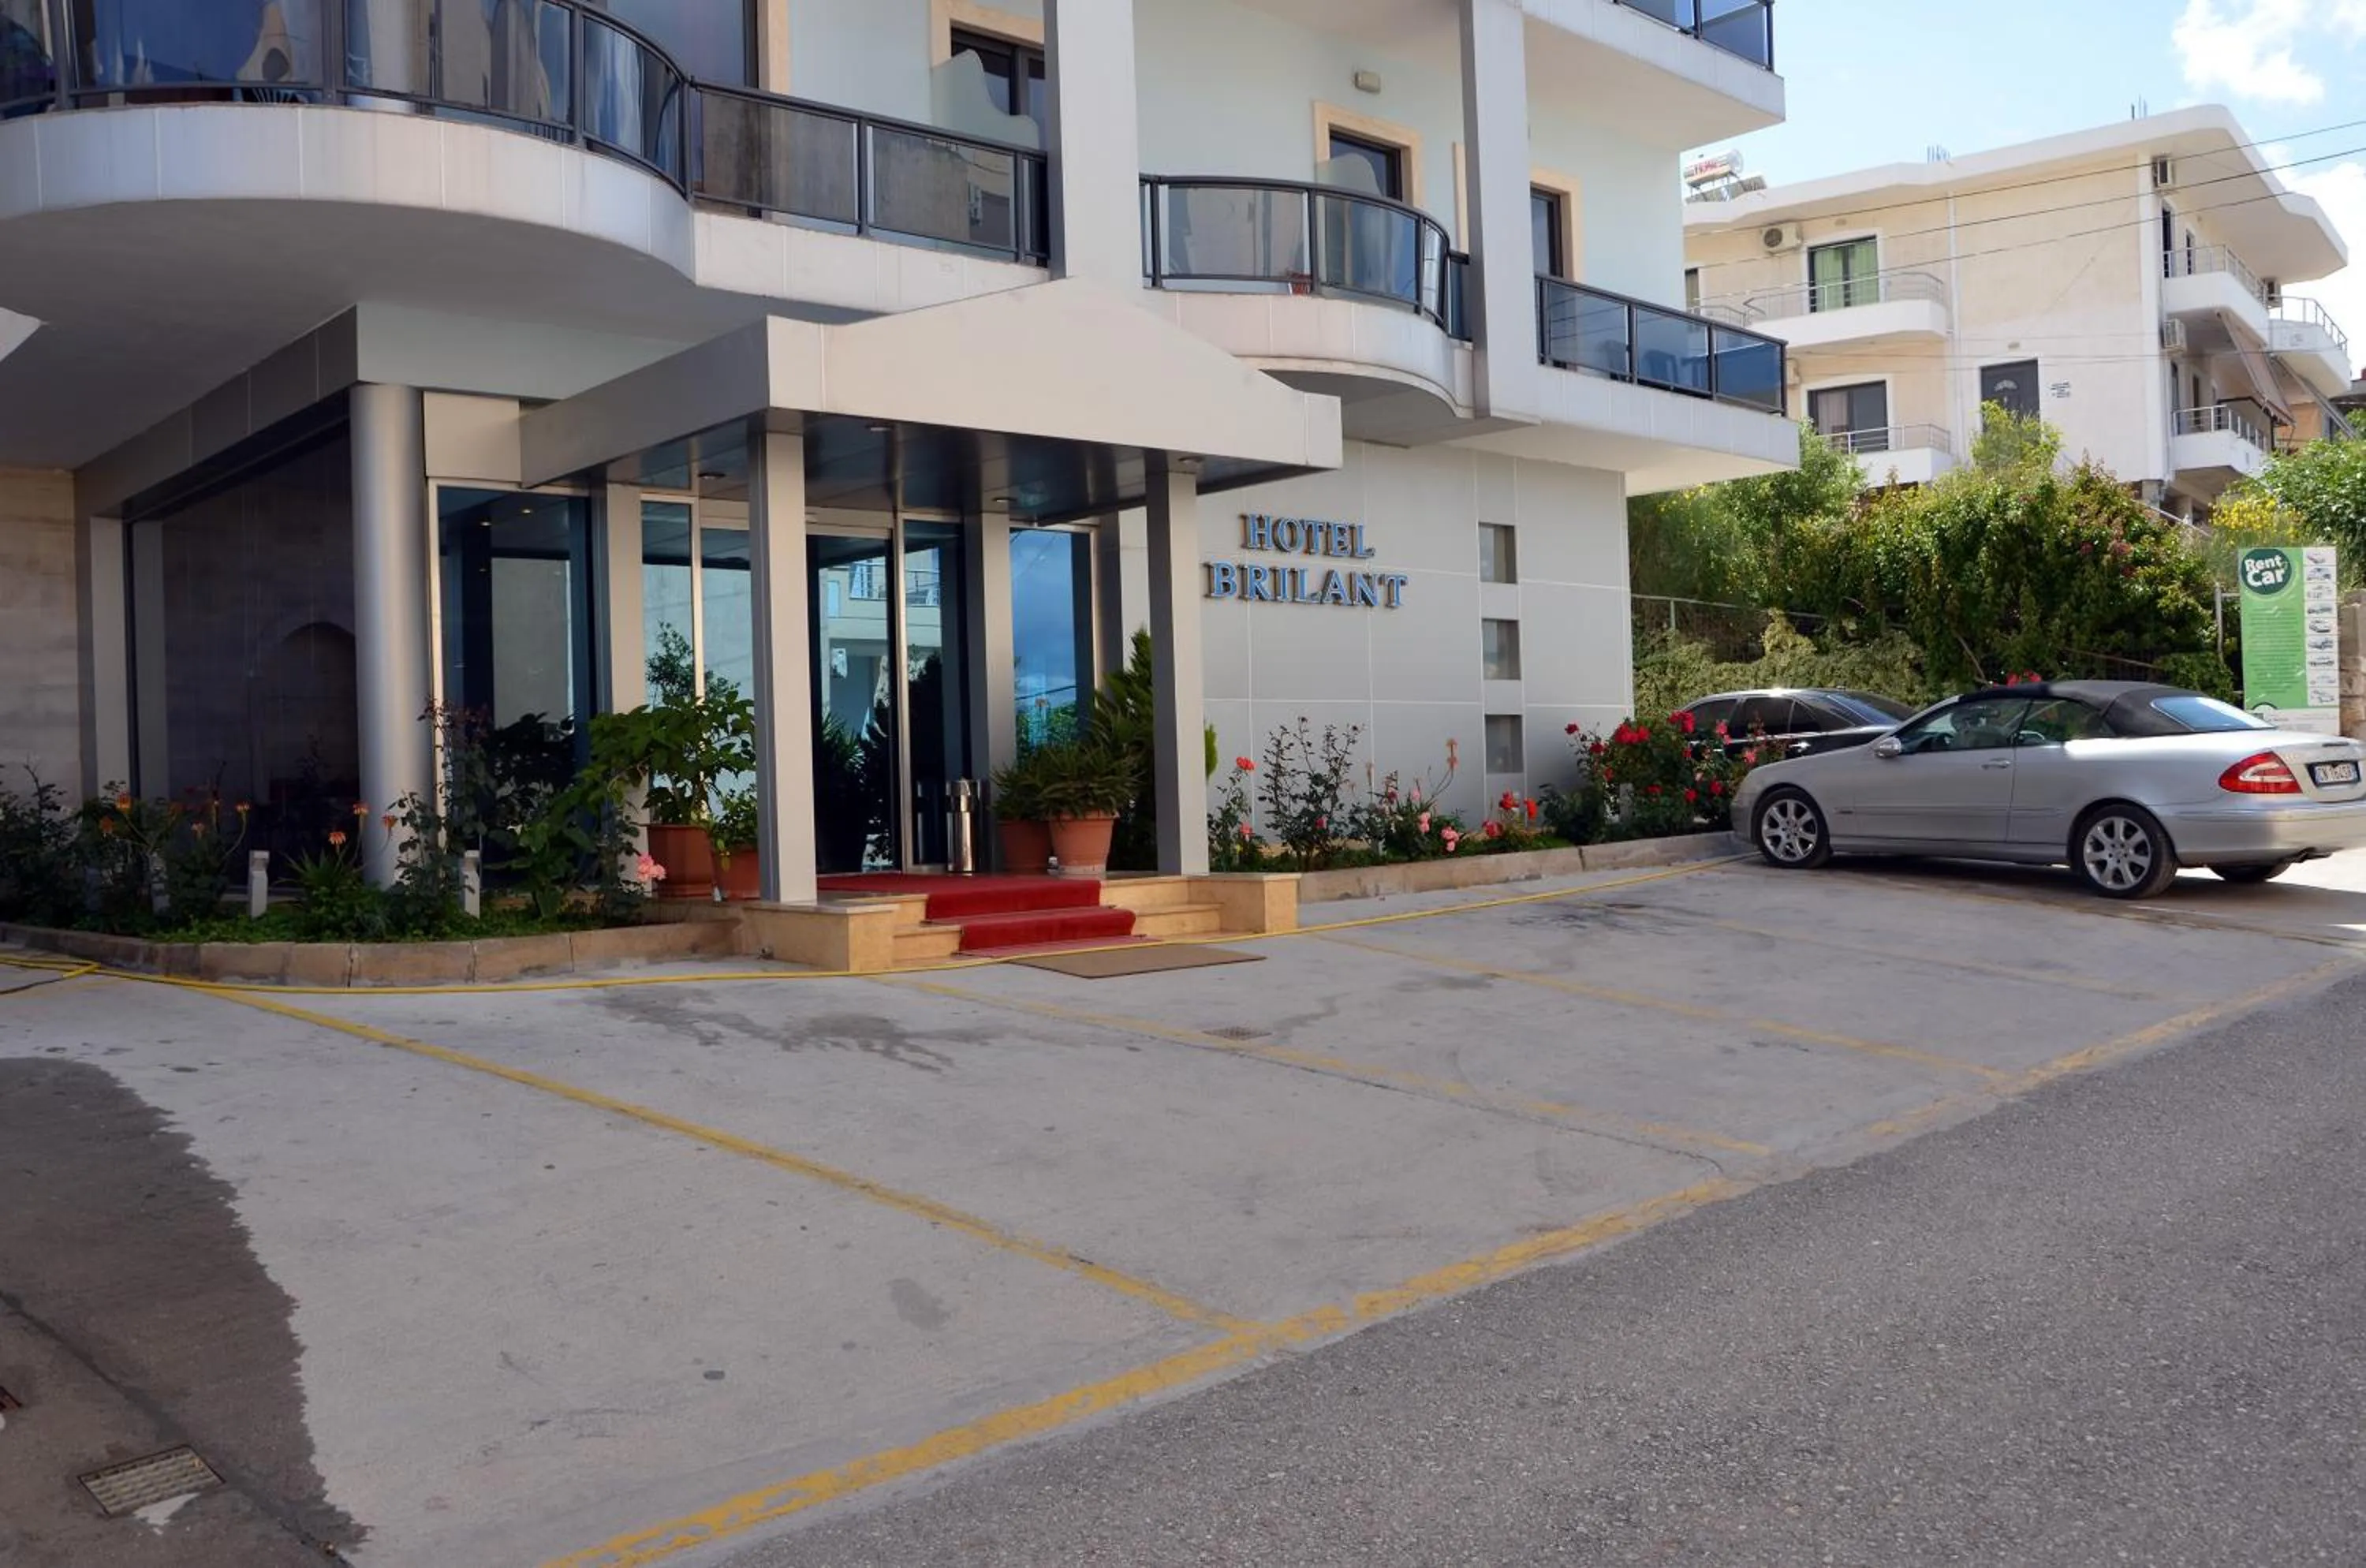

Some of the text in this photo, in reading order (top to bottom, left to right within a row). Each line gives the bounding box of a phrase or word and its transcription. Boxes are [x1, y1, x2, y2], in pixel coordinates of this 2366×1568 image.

[1241, 513, 1375, 558] HOTEL
[2245, 555, 2282, 571] Rent
[2247, 569, 2284, 587] Car
[1204, 561, 1407, 607] BRILANT
